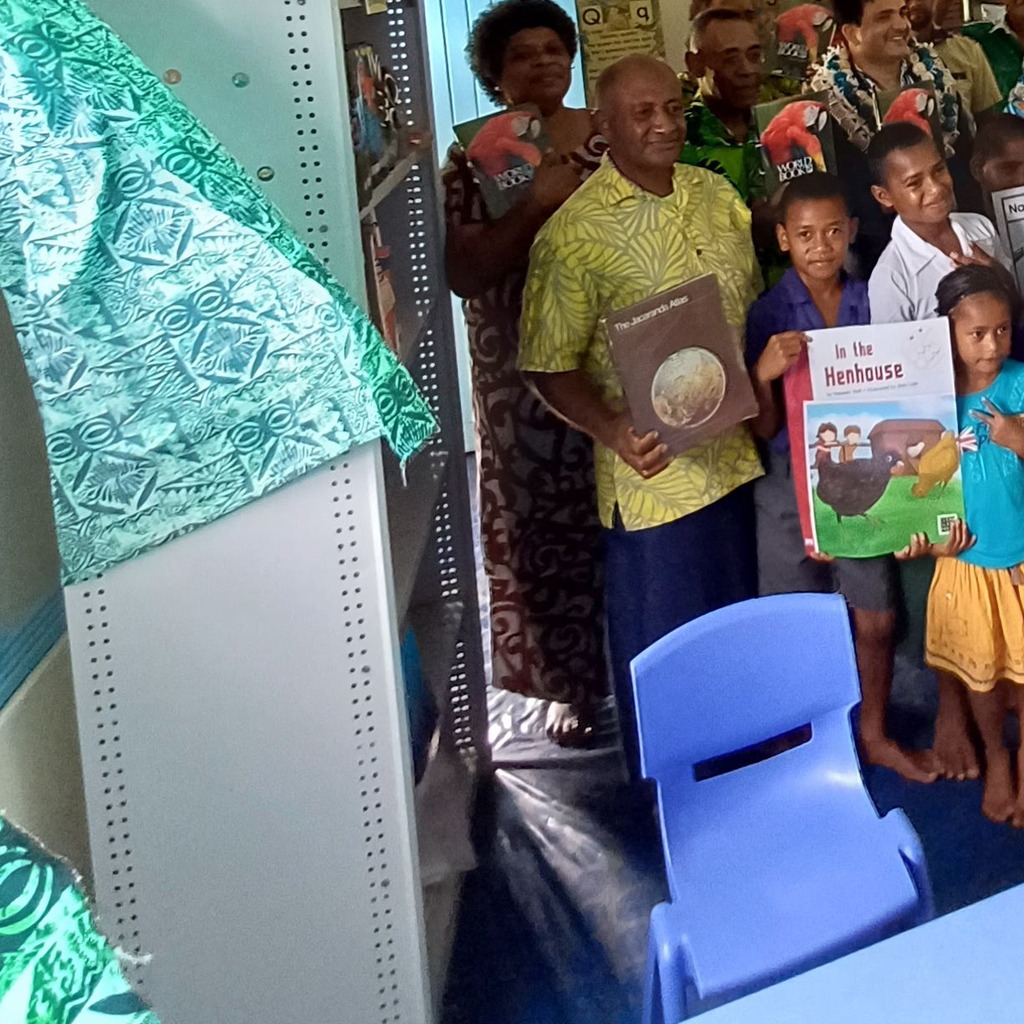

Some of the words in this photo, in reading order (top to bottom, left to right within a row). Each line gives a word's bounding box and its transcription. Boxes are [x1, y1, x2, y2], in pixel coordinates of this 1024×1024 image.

[582, 8, 601, 26] Q
[614, 321, 631, 332] The
[835, 343, 847, 360] In
[853, 341, 874, 358] the
[824, 362, 904, 387] Henhouse
